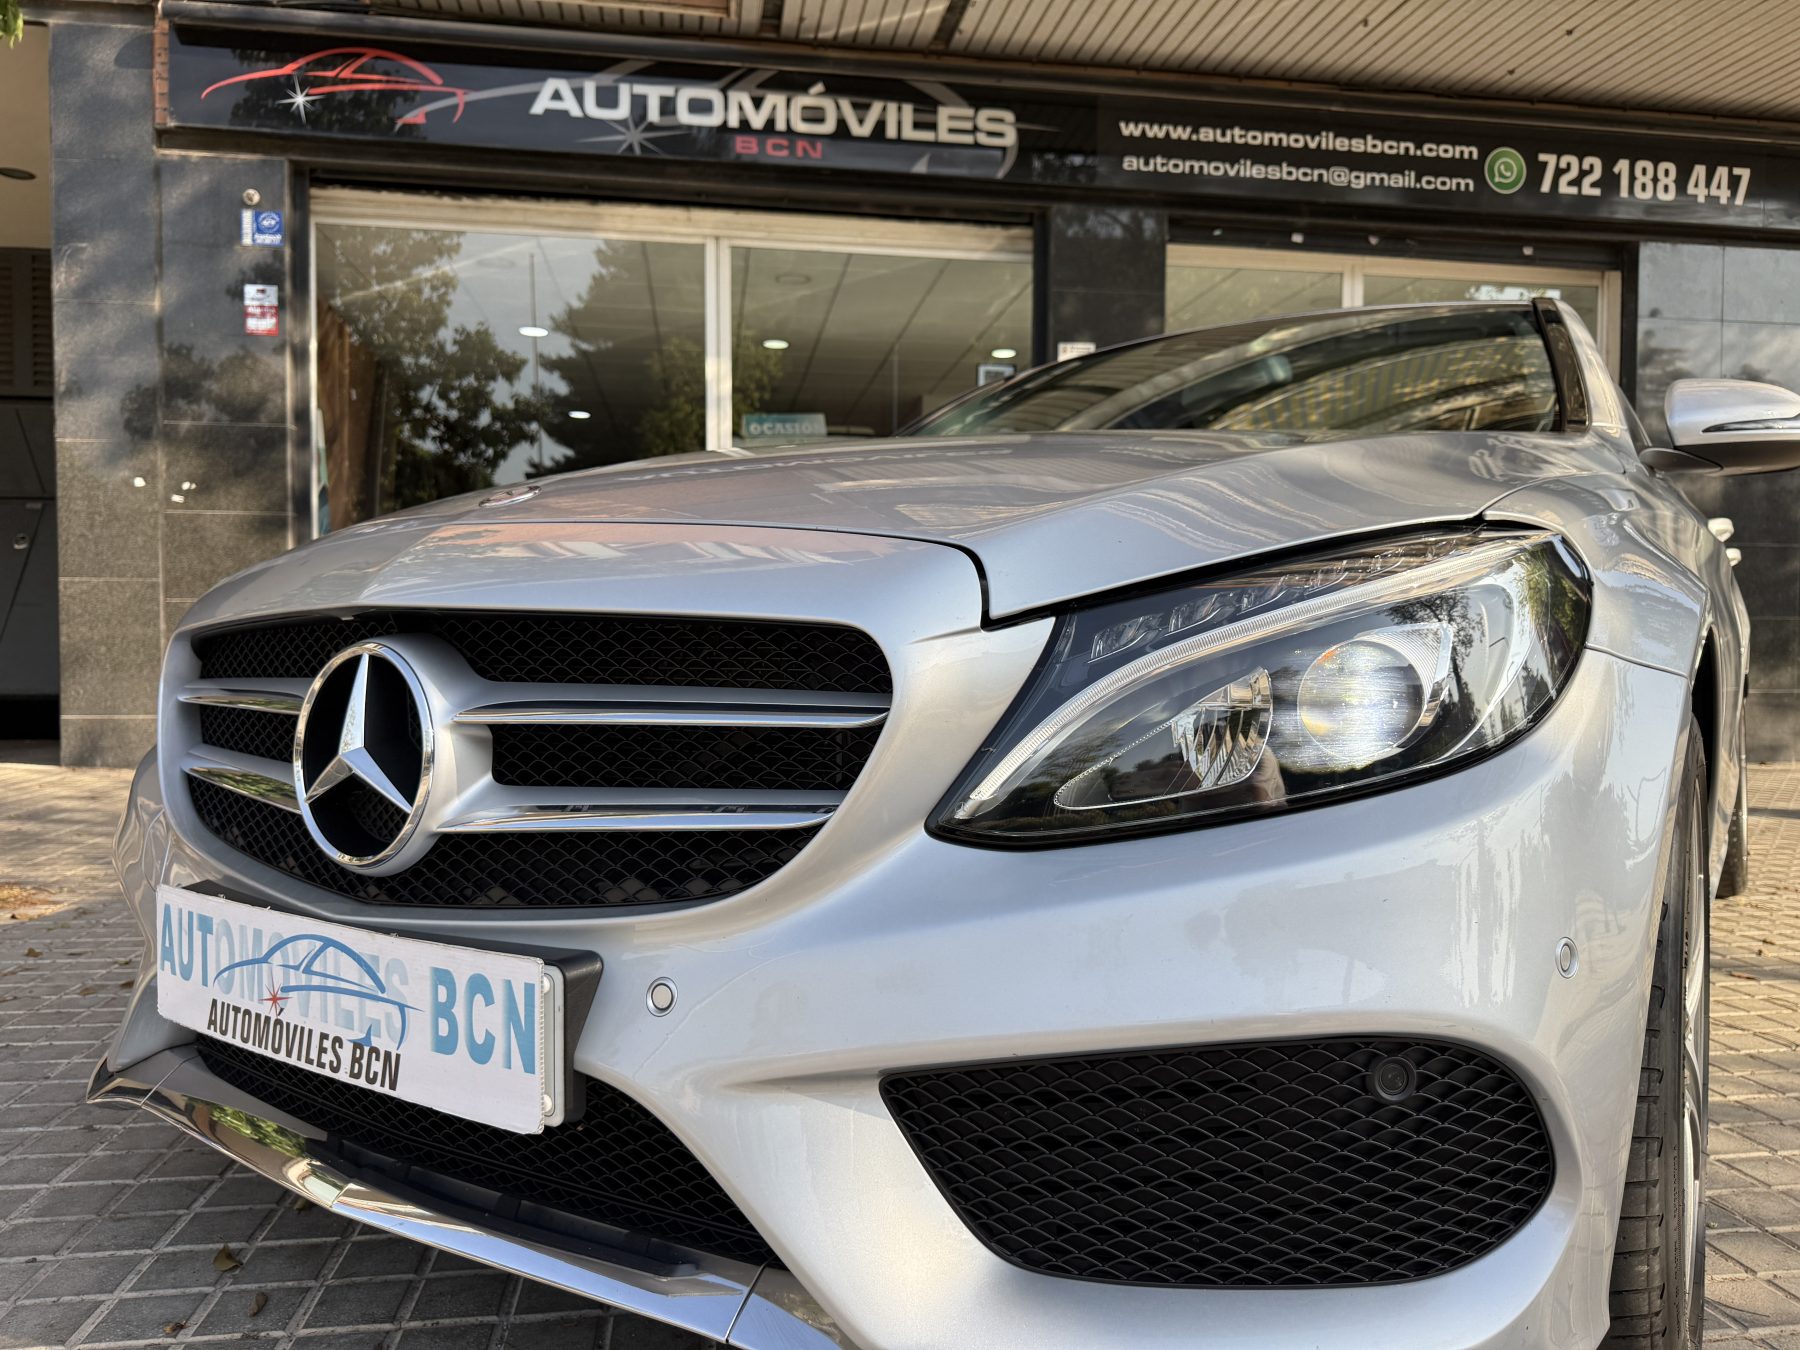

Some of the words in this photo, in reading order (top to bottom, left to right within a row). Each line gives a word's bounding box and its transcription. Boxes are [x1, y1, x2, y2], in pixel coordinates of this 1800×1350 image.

[528, 77, 1017, 147] AUTOMÓVILES
[735, 135, 823, 159] BCN
[1119, 120, 1479, 160] www.automovilesbcn.com
[1122, 154, 1475, 192] automovilesbcn@gmail.com
[1537, 152, 1603, 197] 722
[1612, 158, 1677, 202] 188
[1686, 164, 1751, 207] 447
[207, 998, 342, 1074] AUTOMÓVILES
[348, 1042, 402, 1091] BCN
[429, 966, 536, 1075] BCN
